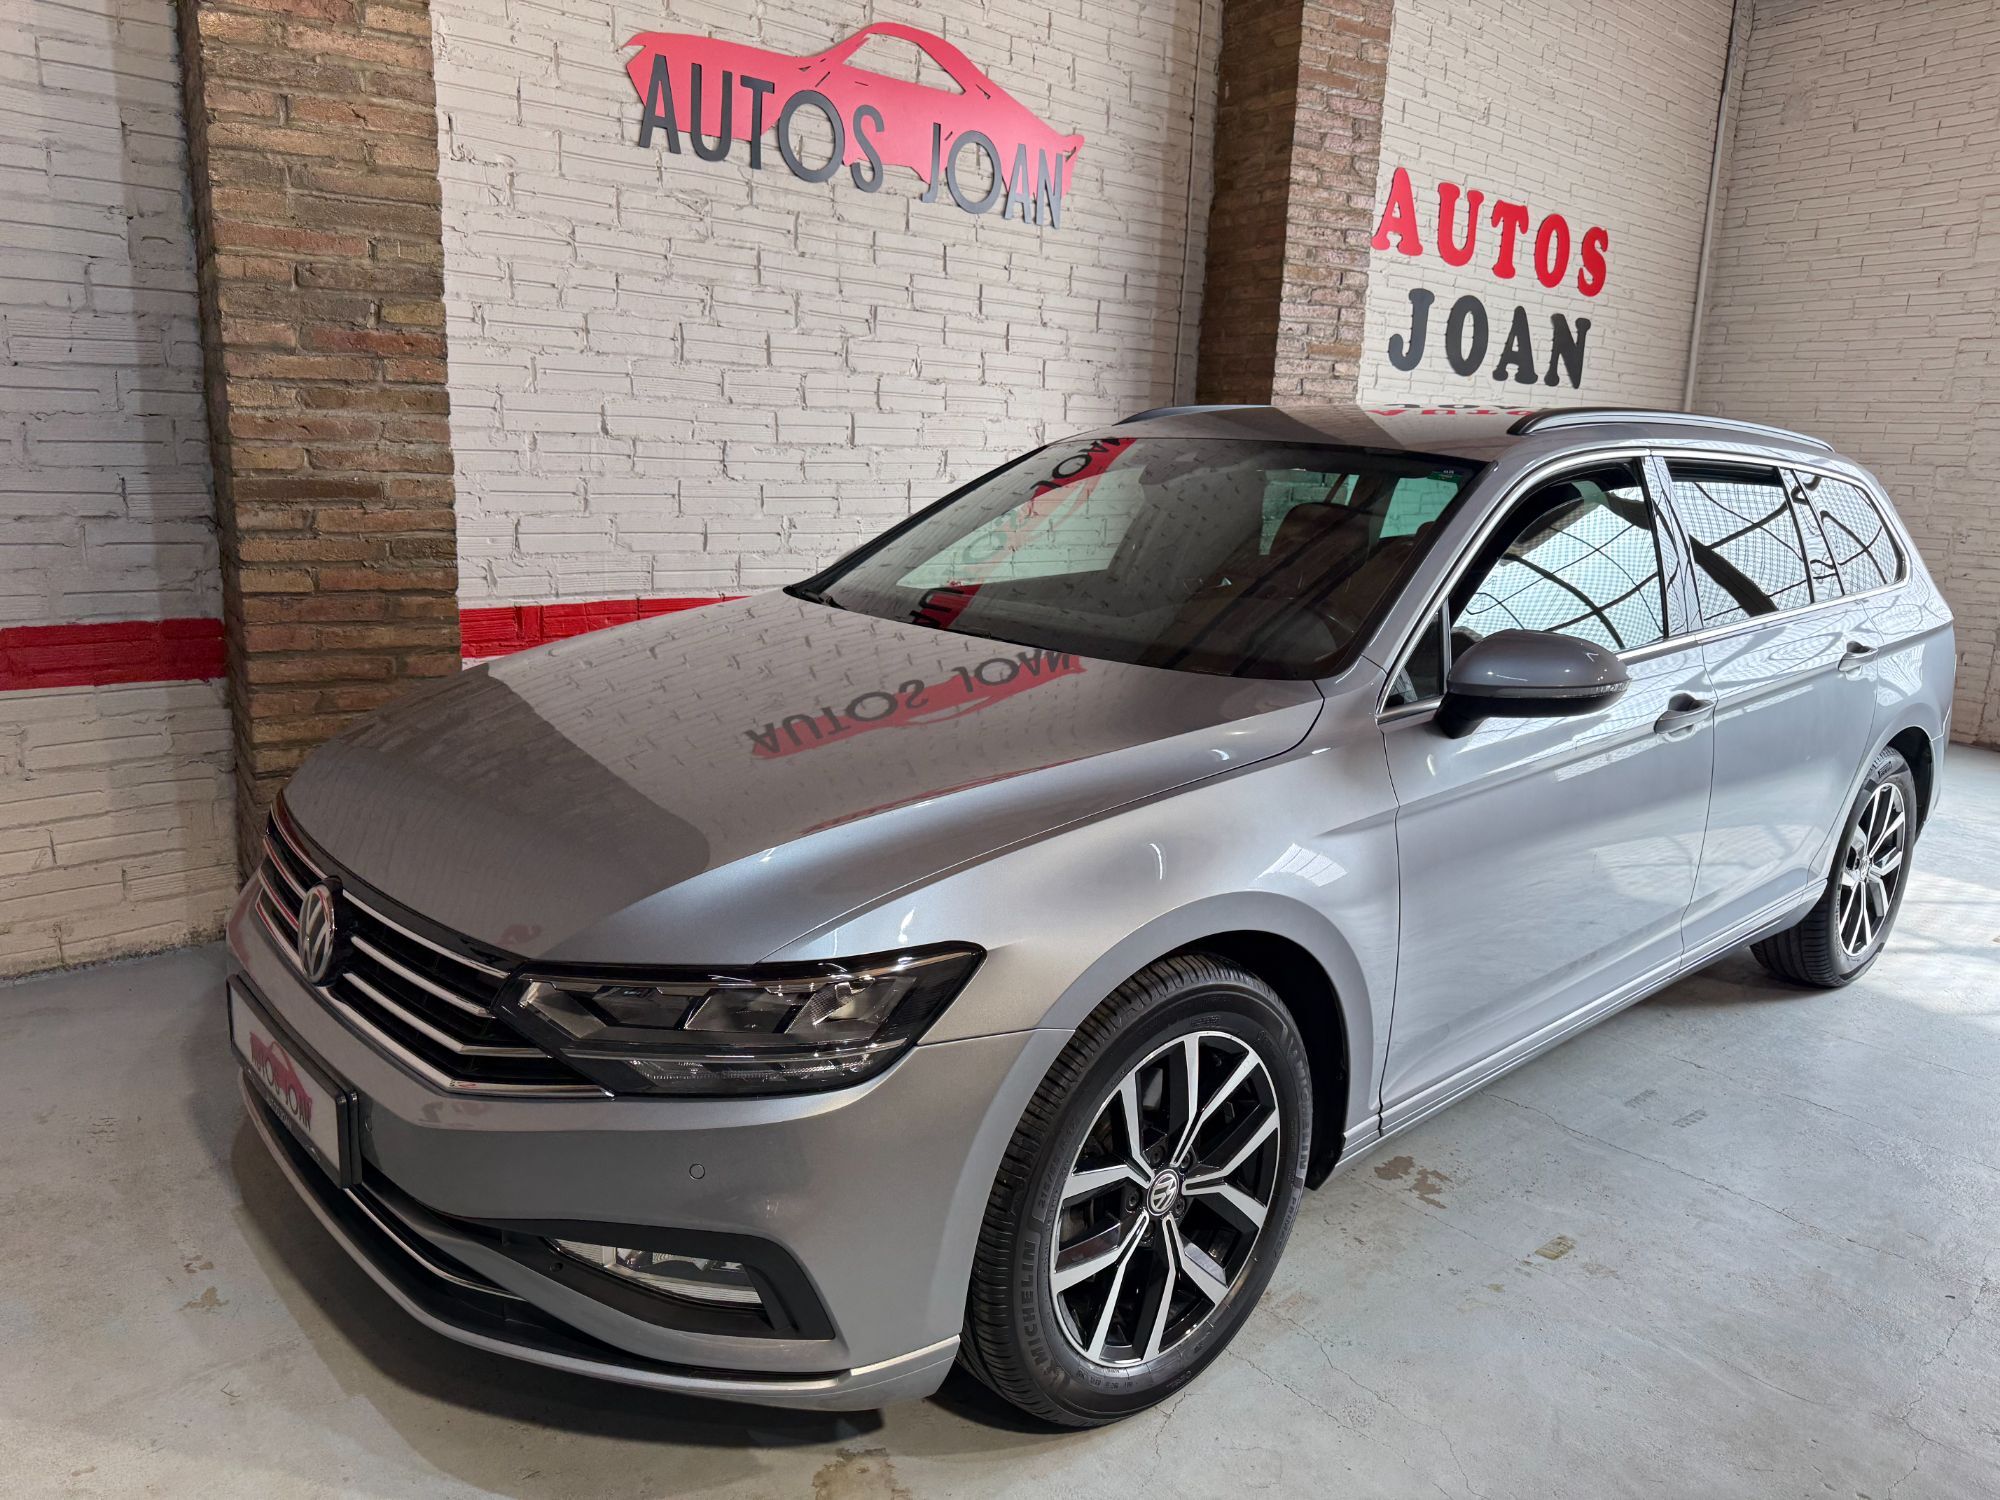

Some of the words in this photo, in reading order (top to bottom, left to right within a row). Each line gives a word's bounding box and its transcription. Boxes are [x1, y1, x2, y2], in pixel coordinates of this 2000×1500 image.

[638, 53, 885, 194] AUTOS
[921, 122, 1064, 230] JOAN
[1370, 166, 1609, 297] AUTOS
[1388, 287, 1592, 390] JOAN
[1021, 1239, 1049, 1367] MICHELIN
